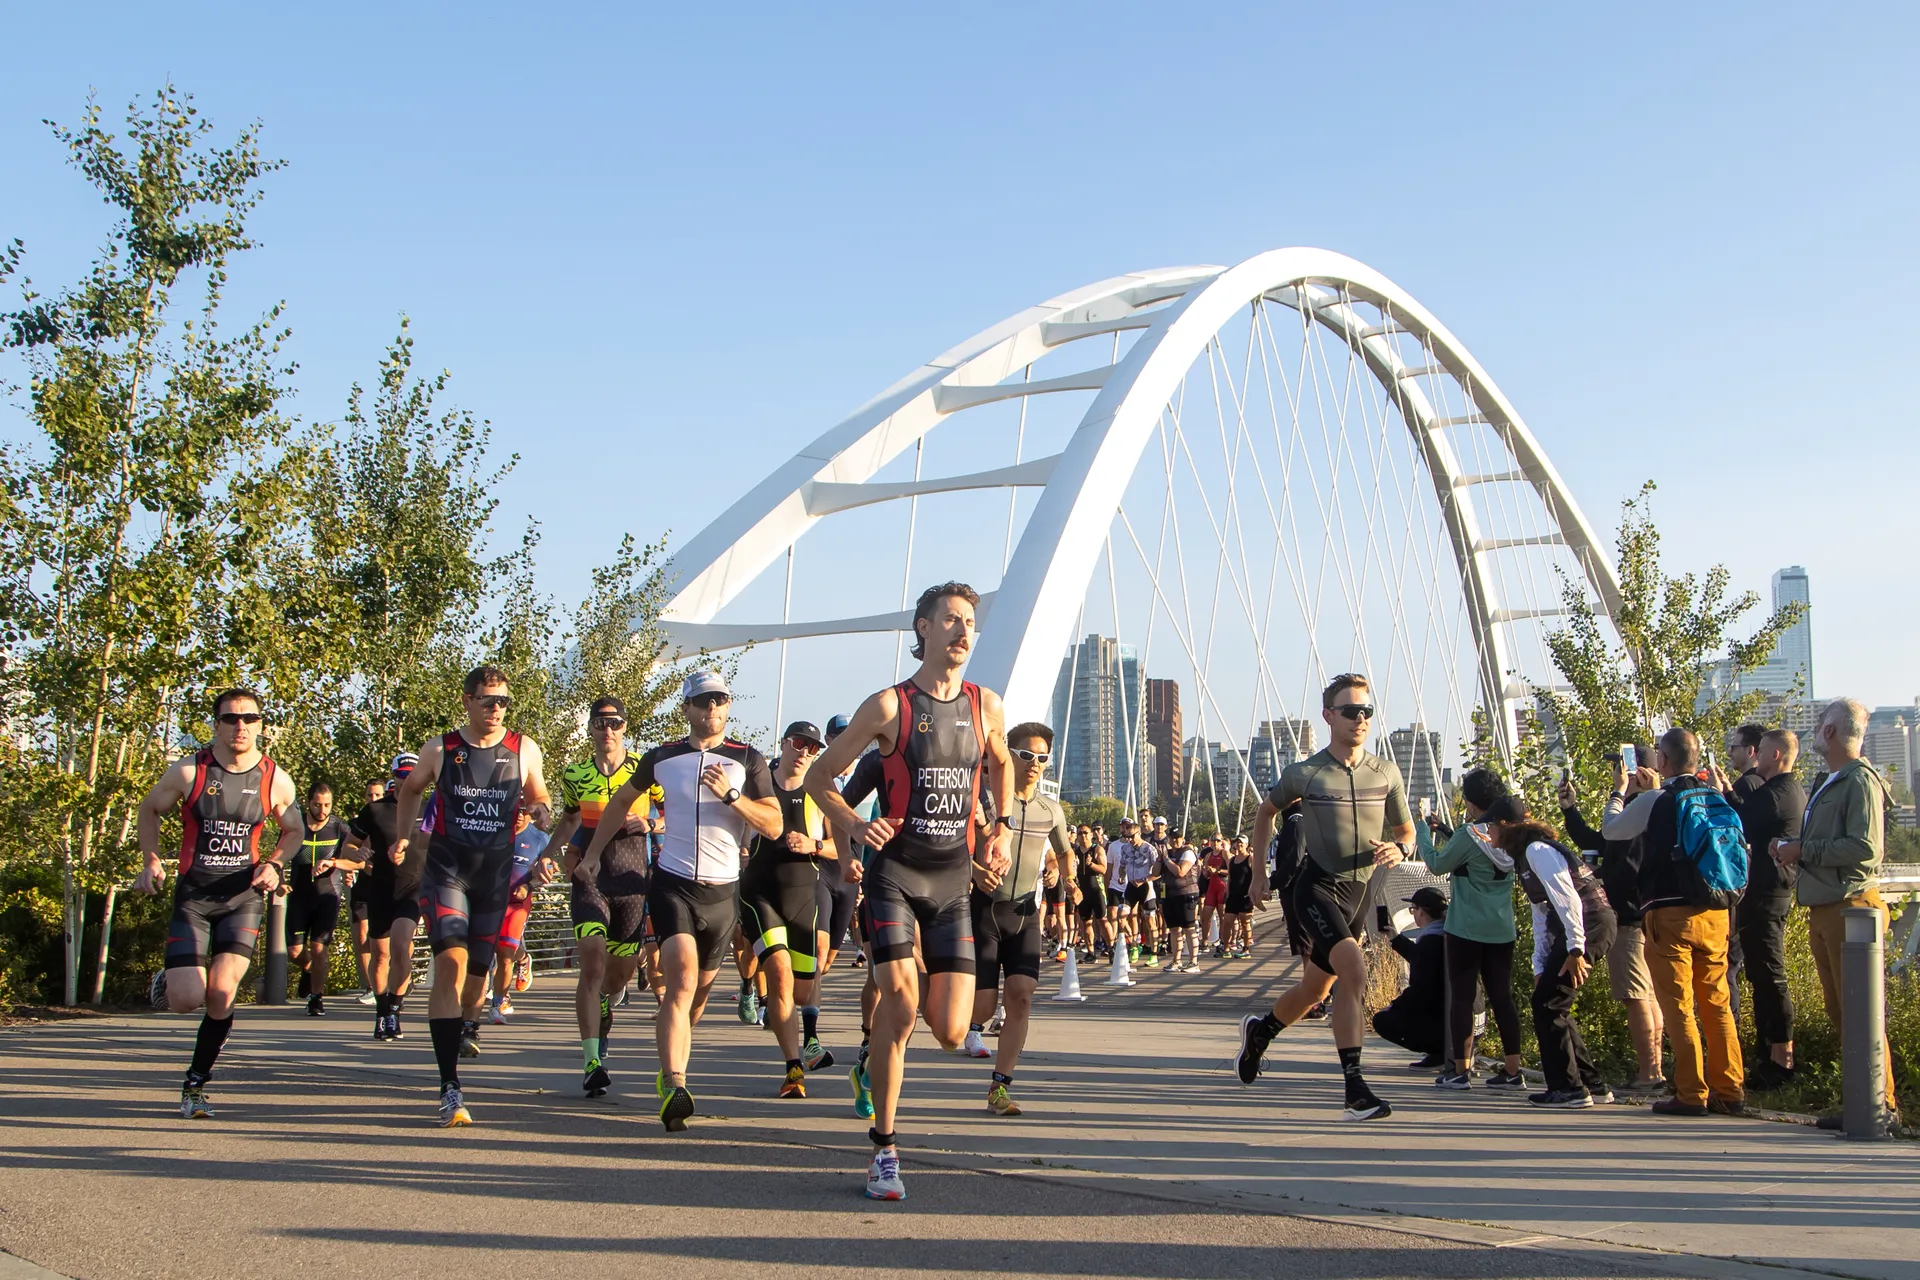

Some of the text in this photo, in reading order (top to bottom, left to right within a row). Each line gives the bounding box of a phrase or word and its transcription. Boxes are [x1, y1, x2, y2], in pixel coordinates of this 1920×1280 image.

[918, 767, 972, 789] PETERSON
[454, 784, 508, 802] Nakonechny
[463, 801, 499, 818] CAN
[925, 793, 963, 815] CAN
[203, 819, 252, 837] BUEHLER
[461, 823, 497, 833] CANADA
[916, 826, 957, 837] CANADA
[208, 838, 243, 854] CAN
[1306, 904, 1334, 939] 2XU
